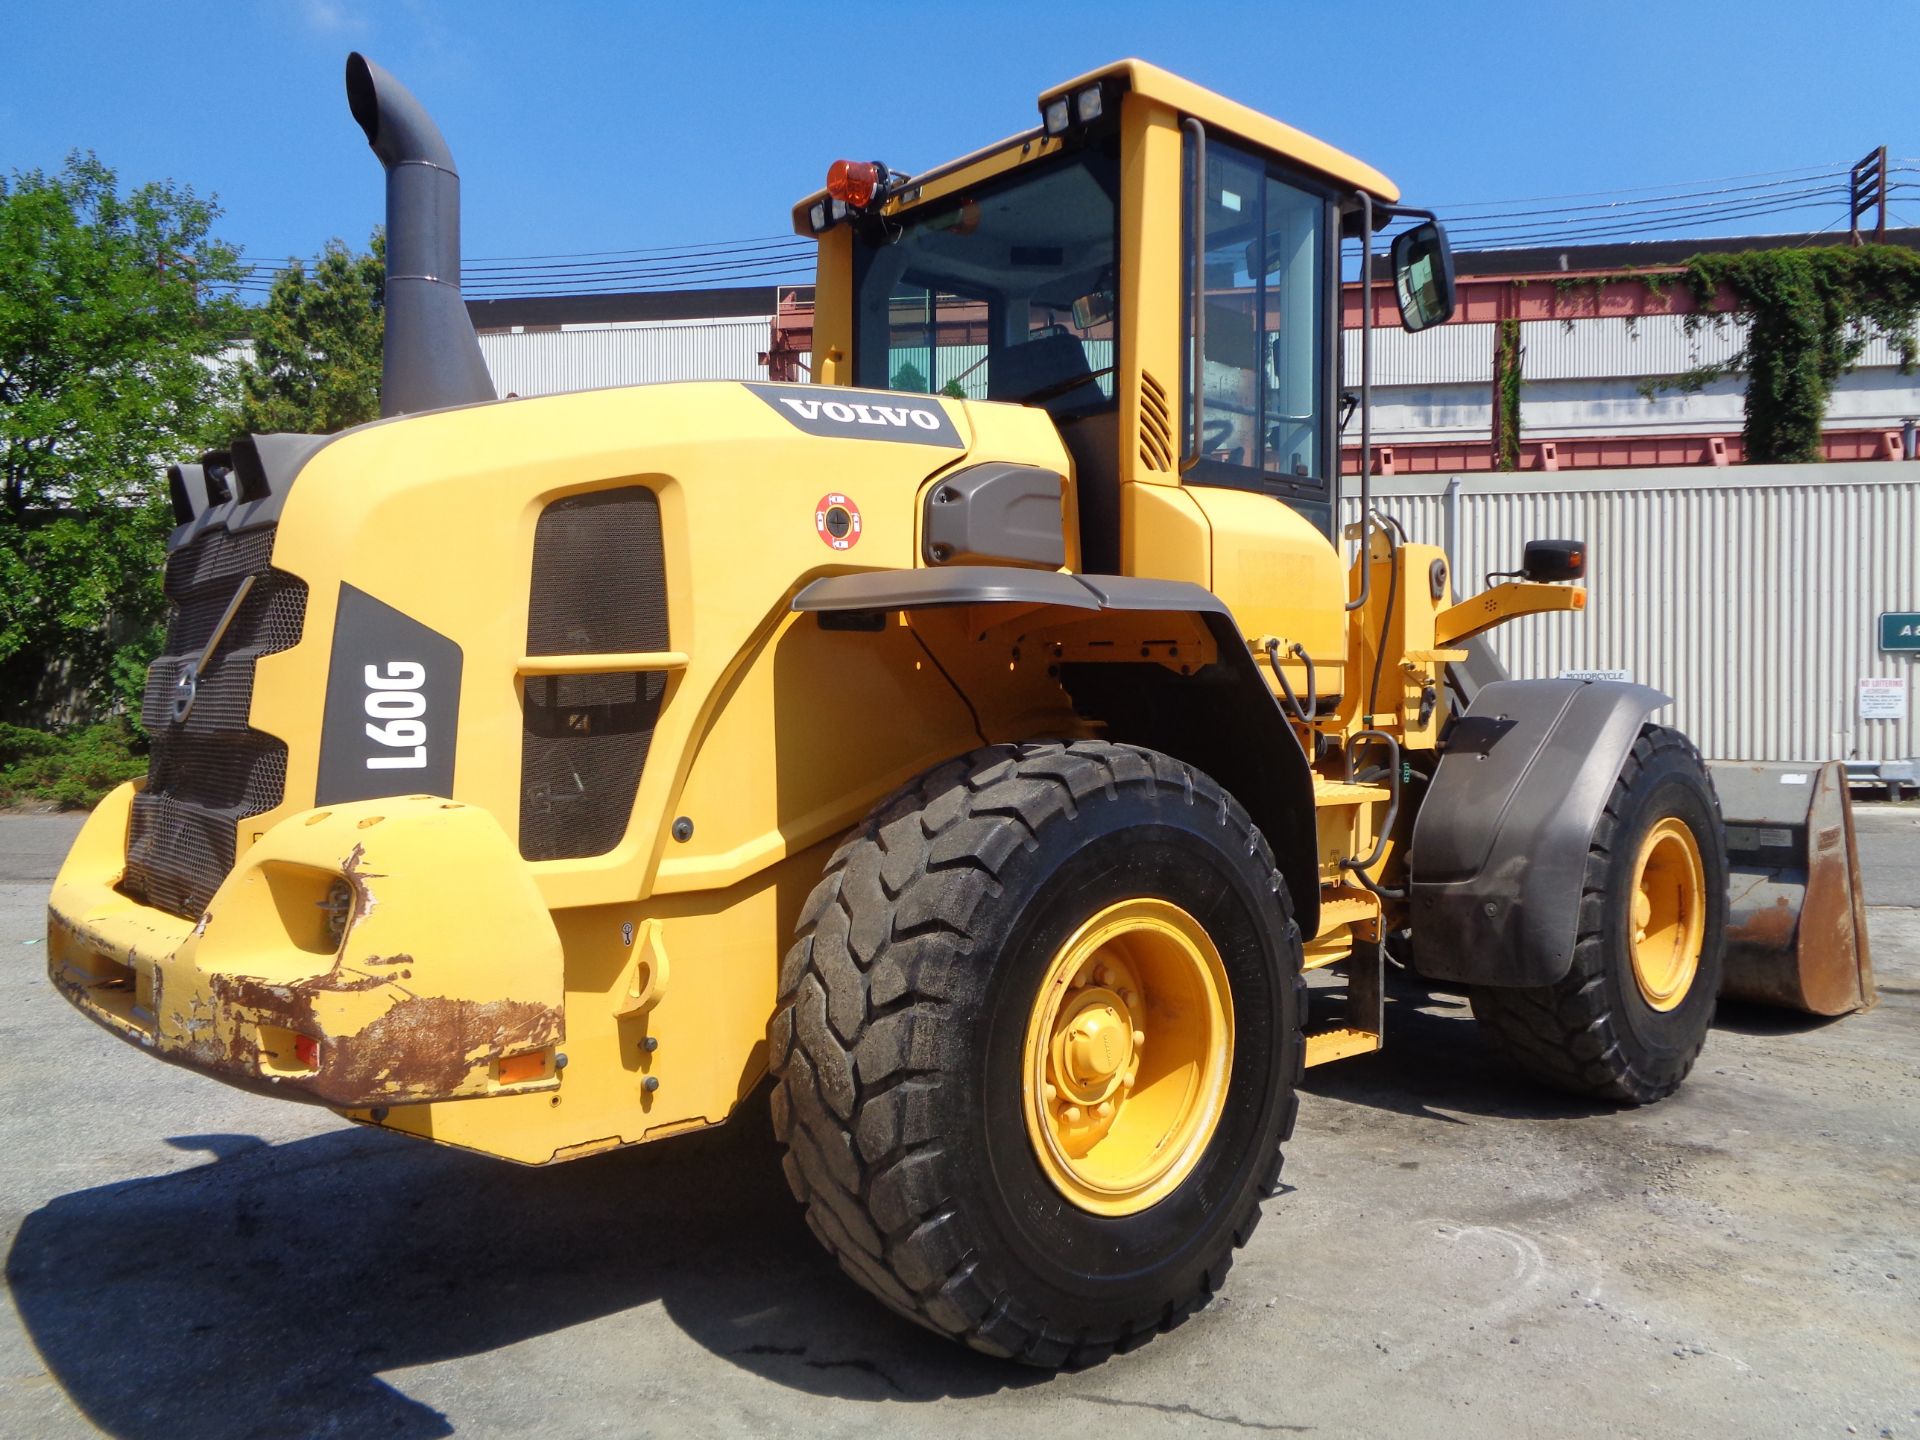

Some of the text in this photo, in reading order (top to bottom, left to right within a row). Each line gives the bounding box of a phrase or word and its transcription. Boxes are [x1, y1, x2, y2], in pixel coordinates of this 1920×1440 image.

[779, 398, 941, 430] VOLVO
[1566, 672, 1624, 680] MOTORCYCLE
[364, 661, 427, 769] L60G
